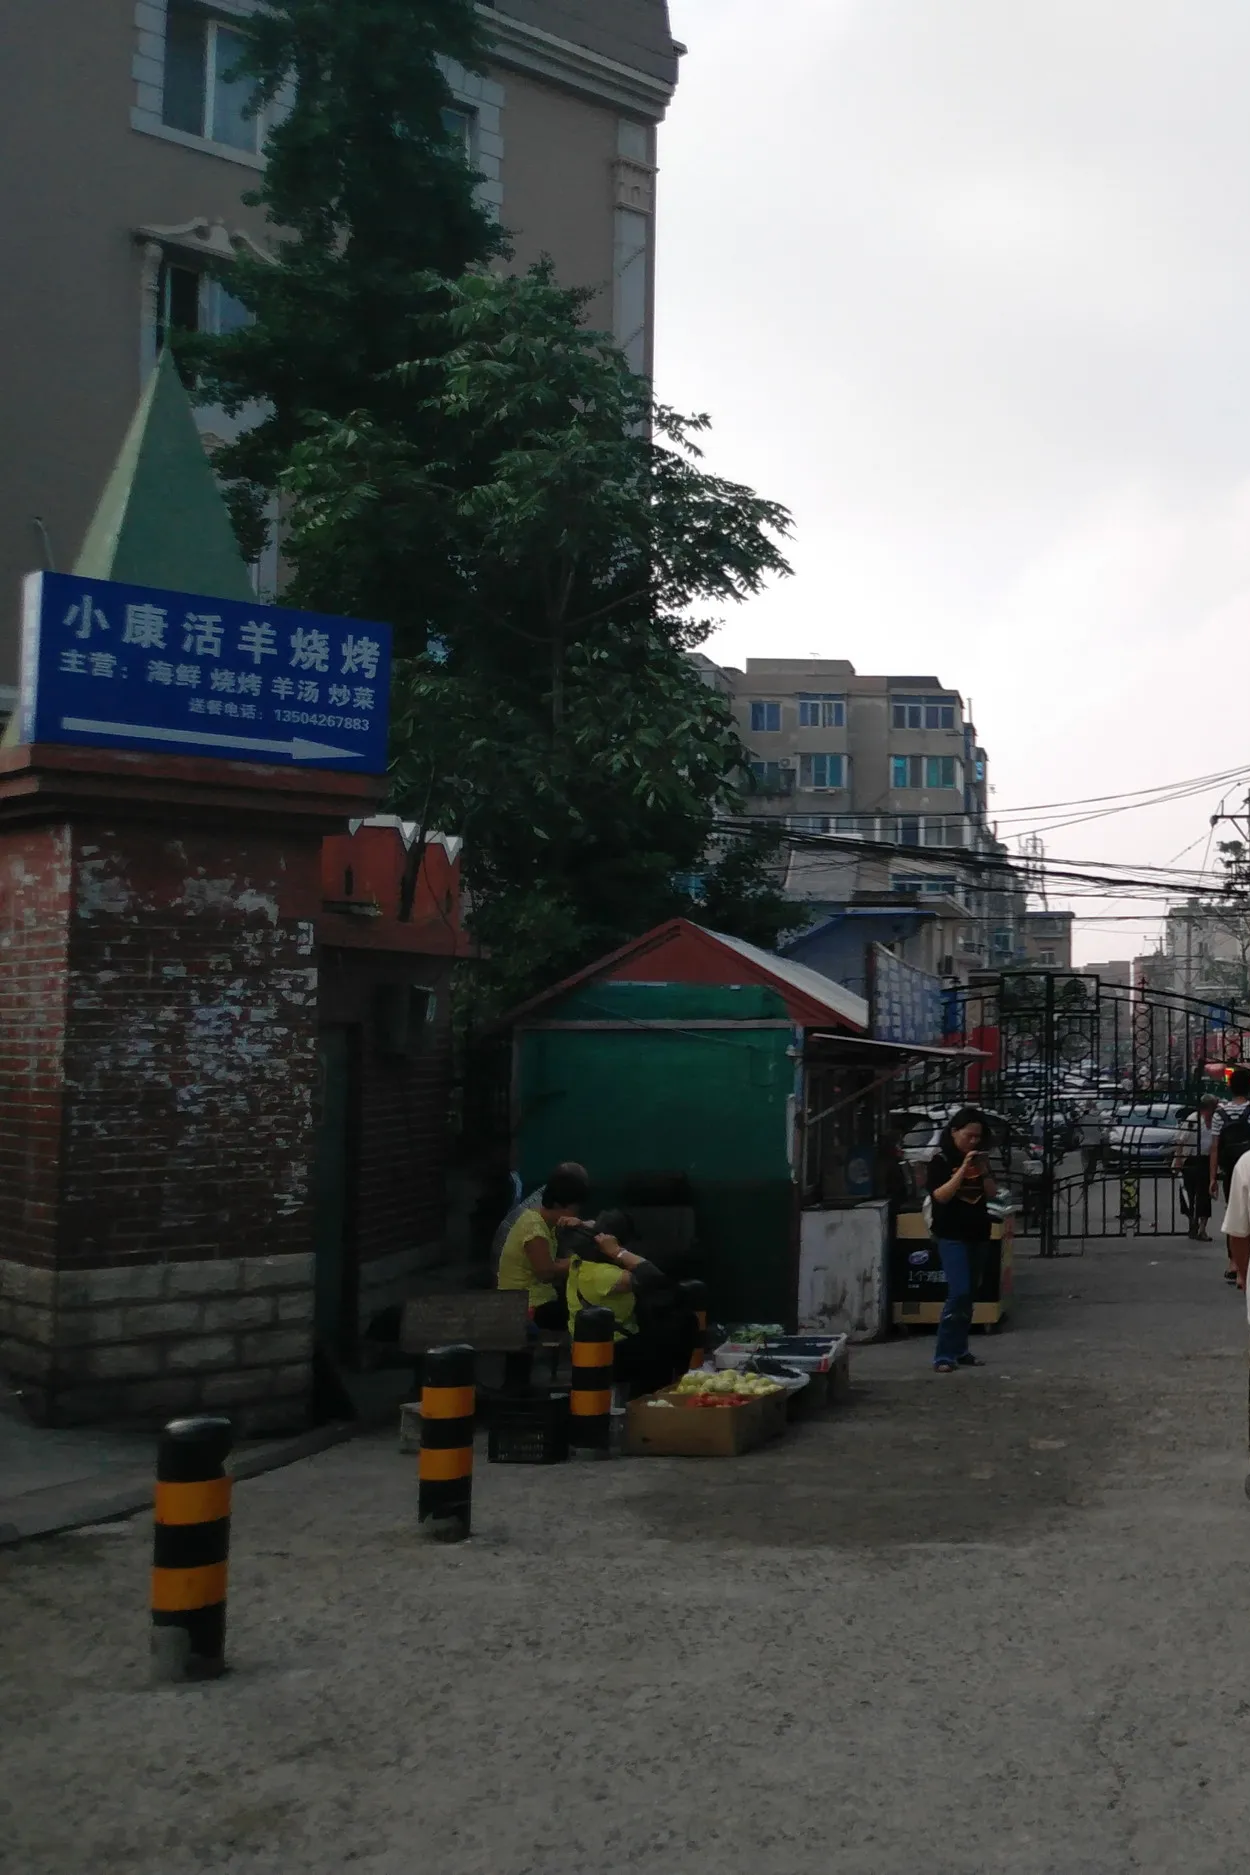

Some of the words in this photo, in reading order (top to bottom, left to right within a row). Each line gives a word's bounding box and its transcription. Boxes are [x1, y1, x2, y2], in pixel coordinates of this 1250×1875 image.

[62, 594, 381, 680] 小康活羊烧烤
[146, 660, 202, 689] 海鲜
[210, 667, 263, 698] 烧烤
[271, 675, 320, 704] 羊汤
[327, 682, 376, 711] 炒菜
[273, 708, 370, 732] 13504267883
